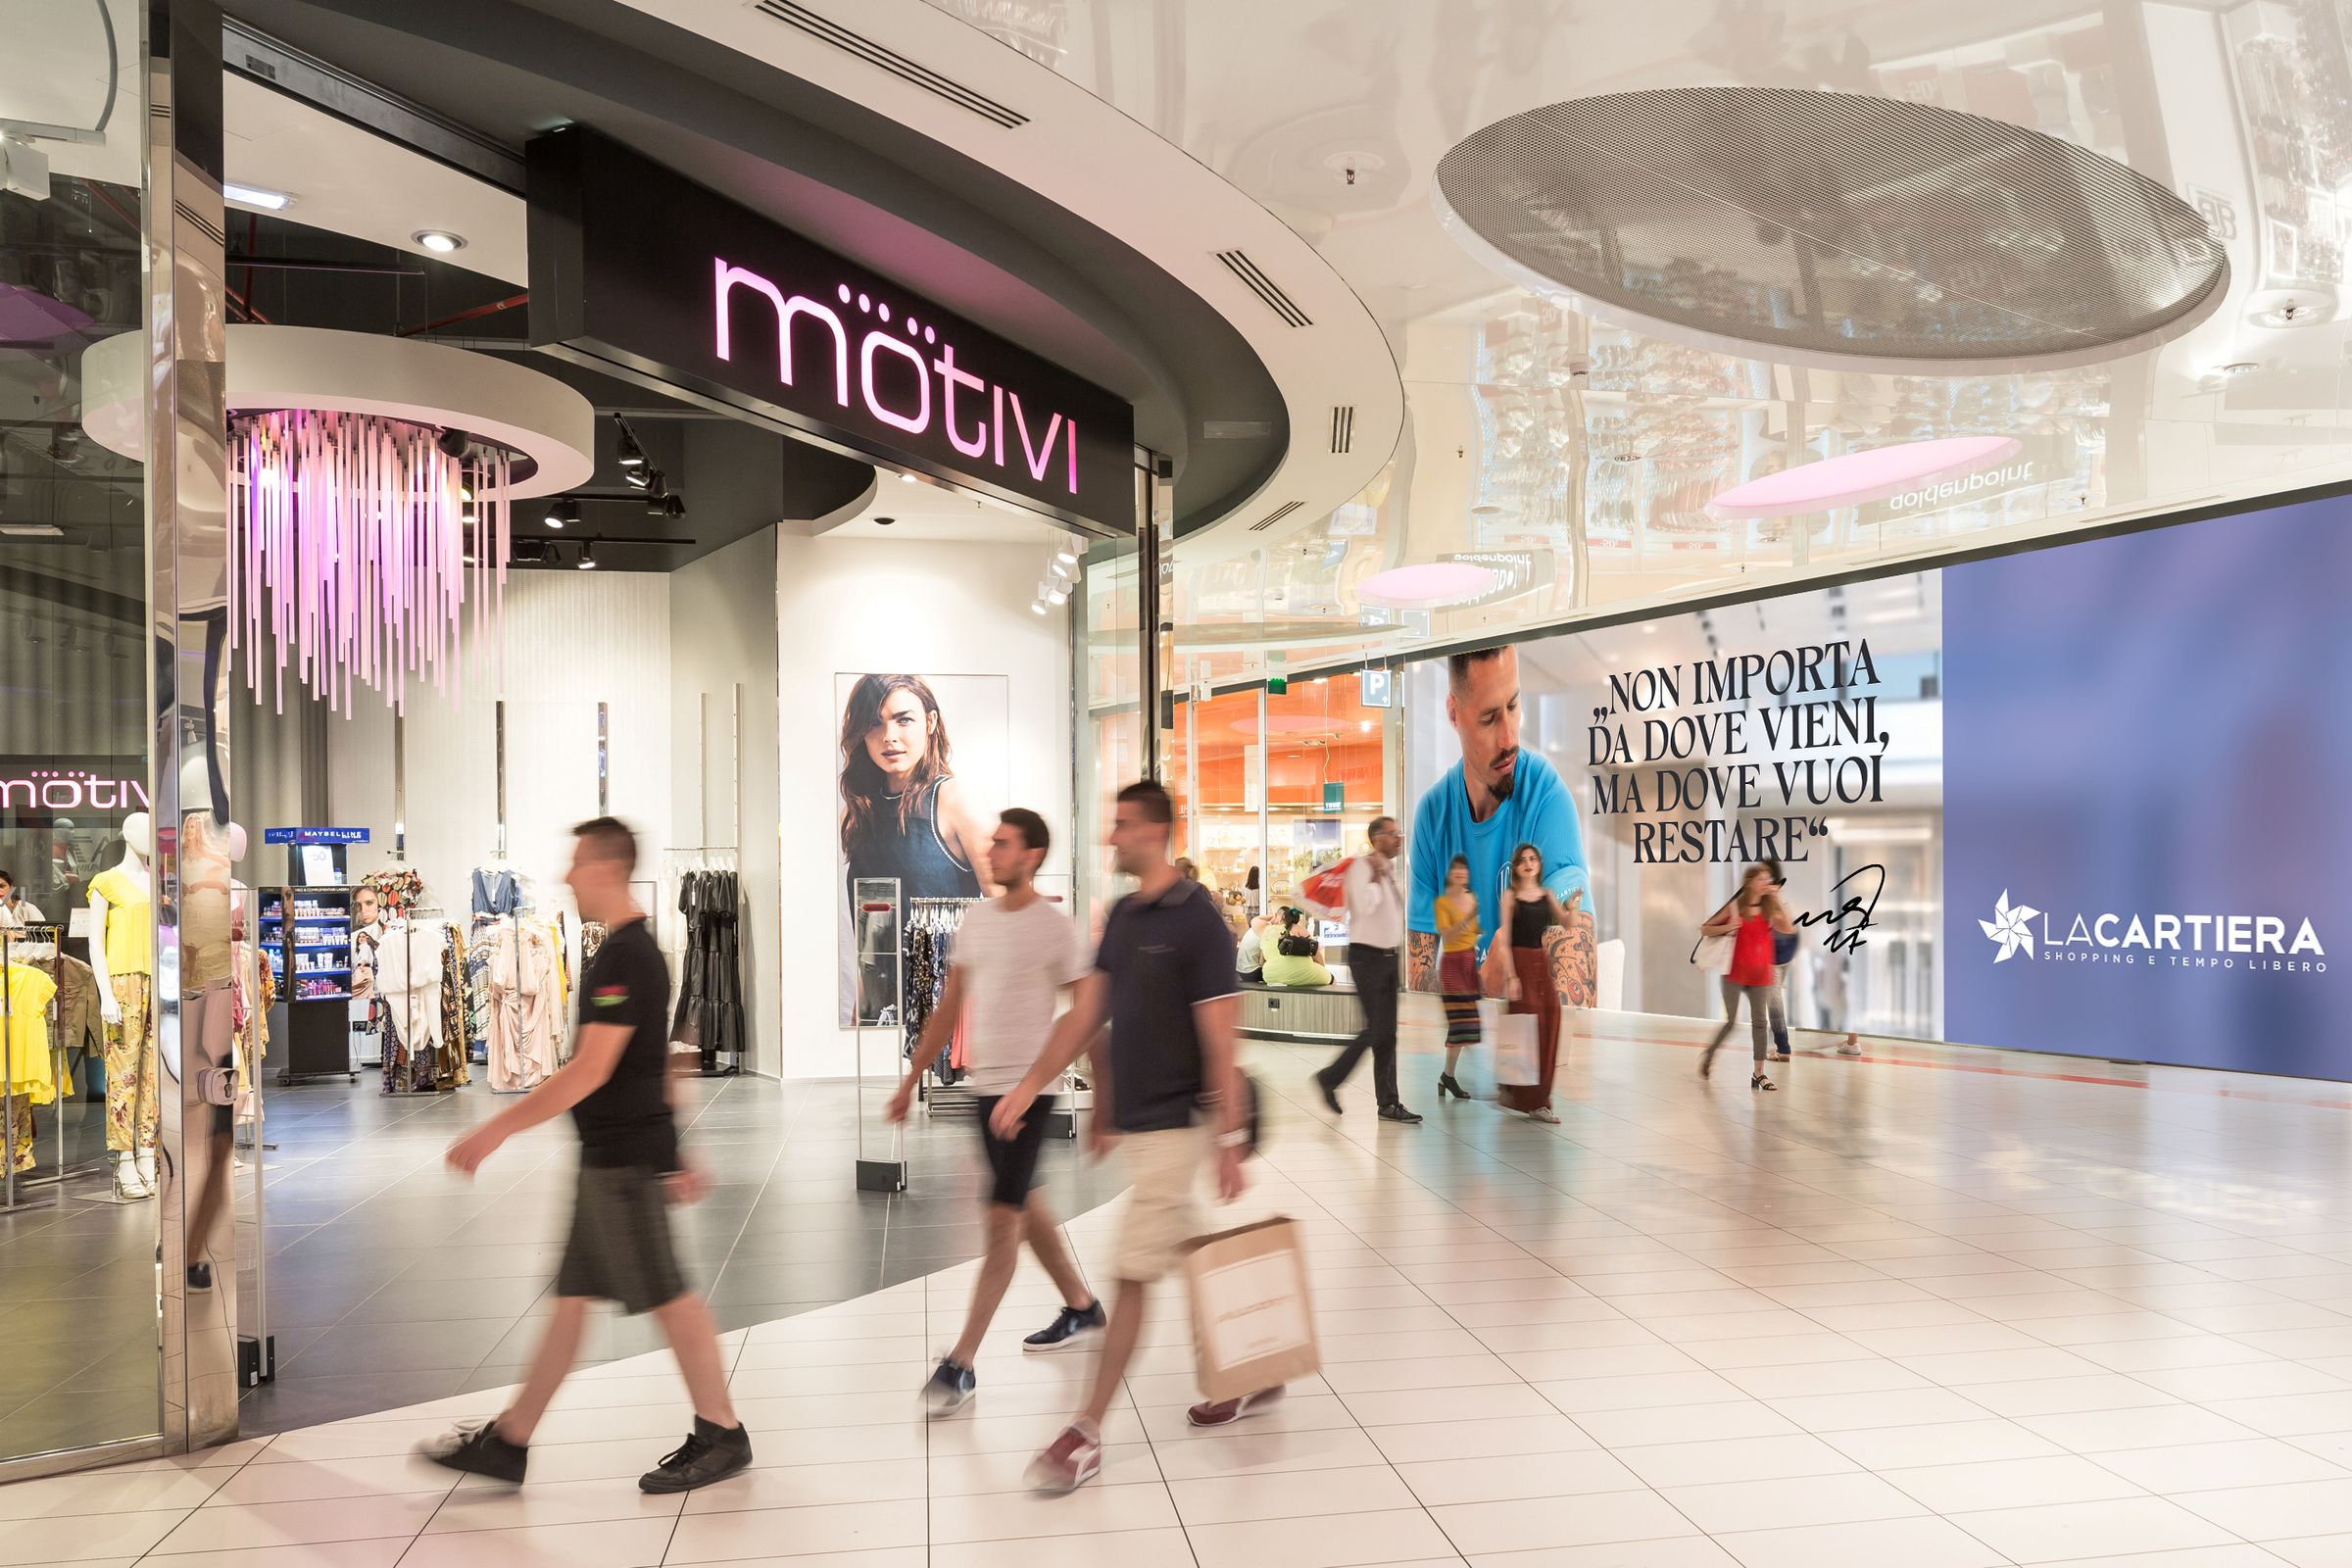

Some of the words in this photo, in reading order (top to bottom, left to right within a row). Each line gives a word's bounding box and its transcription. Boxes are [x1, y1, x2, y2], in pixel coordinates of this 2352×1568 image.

[1370, 673, 1385, 695] P
[1692, 638, 1881, 710] IMPORTA
[1588, 723, 1634, 766] DA
[1643, 710, 1748, 762] DOVE
[1758, 696, 1889, 753] VIENI,
[1592, 772, 1645, 814] MA
[1656, 763, 1761, 812] DOVE
[1771, 755, 1884, 806] VUOI
[2043, 951, 2135, 964] SHOPPING
[2148, 956, 2156, 965] E
[2170, 956, 2234, 968] TEMPO
[2249, 959, 2328, 973] LIBERO
